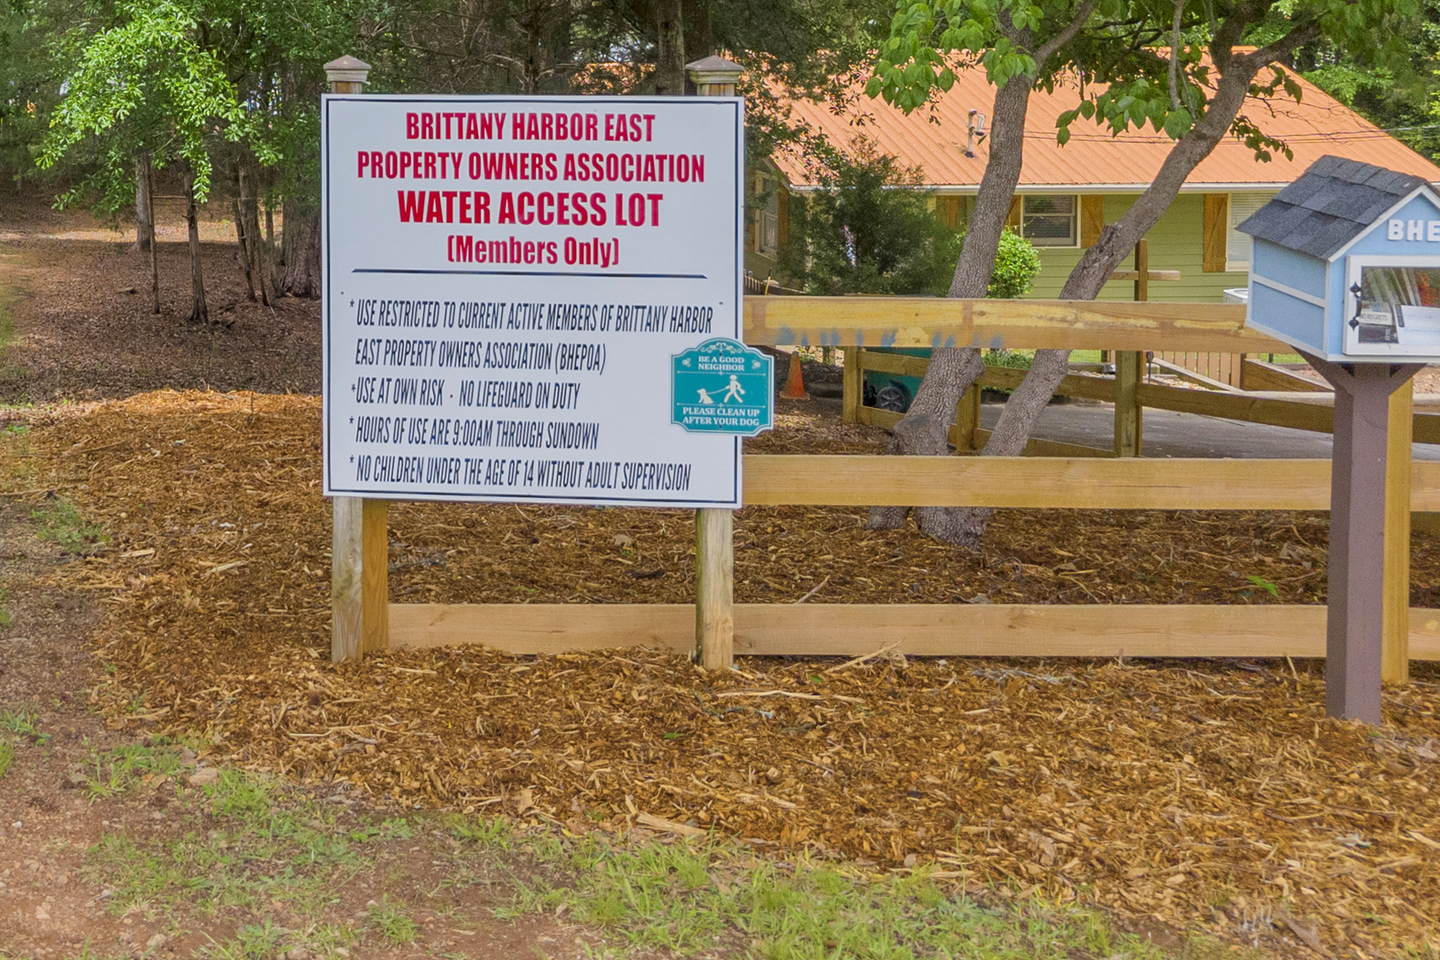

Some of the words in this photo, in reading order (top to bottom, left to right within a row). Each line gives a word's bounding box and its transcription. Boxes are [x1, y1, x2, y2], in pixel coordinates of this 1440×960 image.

[406, 112, 506, 140] BRITTANY
[512, 112, 598, 141] HARBOR
[604, 113, 656, 142] EAST
[357, 151, 463, 179] PROPERTY
[468, 152, 558, 181] OWNERS
[563, 153, 705, 183] ASSOCIATION
[397, 190, 491, 224] WATER
[498, 191, 607, 226] ACCESS
[615, 193, 664, 227] LOT
[447, 235, 558, 265] (Members
[564, 236, 620, 268] Only)
[356, 299, 377, 326] USE
[378, 300, 441, 328] RESTRICTED
[443, 301, 456, 328] TO
[458, 302, 506, 330] CURRENT
[506, 302, 546, 330] ACTIVE
[546, 303, 598, 332] MEMBERS
[599, 304, 614, 332] OF
[615, 305, 669, 333] BRITTANY
[669, 306, 714, 334] HARBOR
[355, 338, 382, 365] EAST
[383, 339, 437, 367] PROPERTY
[438, 340, 483, 368] OWNERS
[483, 342, 553, 370] ASSOCIATION
[555, 343, 607, 376] (BHEPOA)
[698, 363, 745, 371] NEIGHBOR
[719, 356, 745, 364] GOOD
[377, 377, 392, 404] AT
[393, 378, 418, 405] OWN
[420, 379, 445, 406] RISK
[459, 380, 475, 407] NO
[476, 380, 533, 408] LIFEGUARD
[535, 381, 551, 409] ON
[552, 382, 581, 409] DUTY
[682, 407, 716, 415] PLEASE
[717, 408, 745, 416] CLEAN
[747, 409, 760, 417] UP
[682, 416, 712, 425] AFTER
[713, 417, 738, 426] YOUR
[740, 418, 760, 427] DOG
[355, 416, 391, 443] HOURS
[392, 416, 407, 444] OF
[408, 417, 428, 445] USE
[429, 418, 451, 445] ARE
[452, 419, 494, 447] 9:00AM
[495, 420, 544, 448] THROUGH
[545, 421, 599, 449] SUNDOWN
[356, 455, 371, 481] NO
[373, 455, 426, 483] CHILDREN
[426, 457, 461, 484] UNDER
[463, 458, 483, 485] THE
[484, 458, 506, 485] AGE
[507, 459, 522, 486] OF
[523, 460, 535, 486] 14
[536, 460, 584, 488] WITHOUT
[584, 461, 620, 489] ADULT
[621, 462, 692, 491] SUPERVISION
